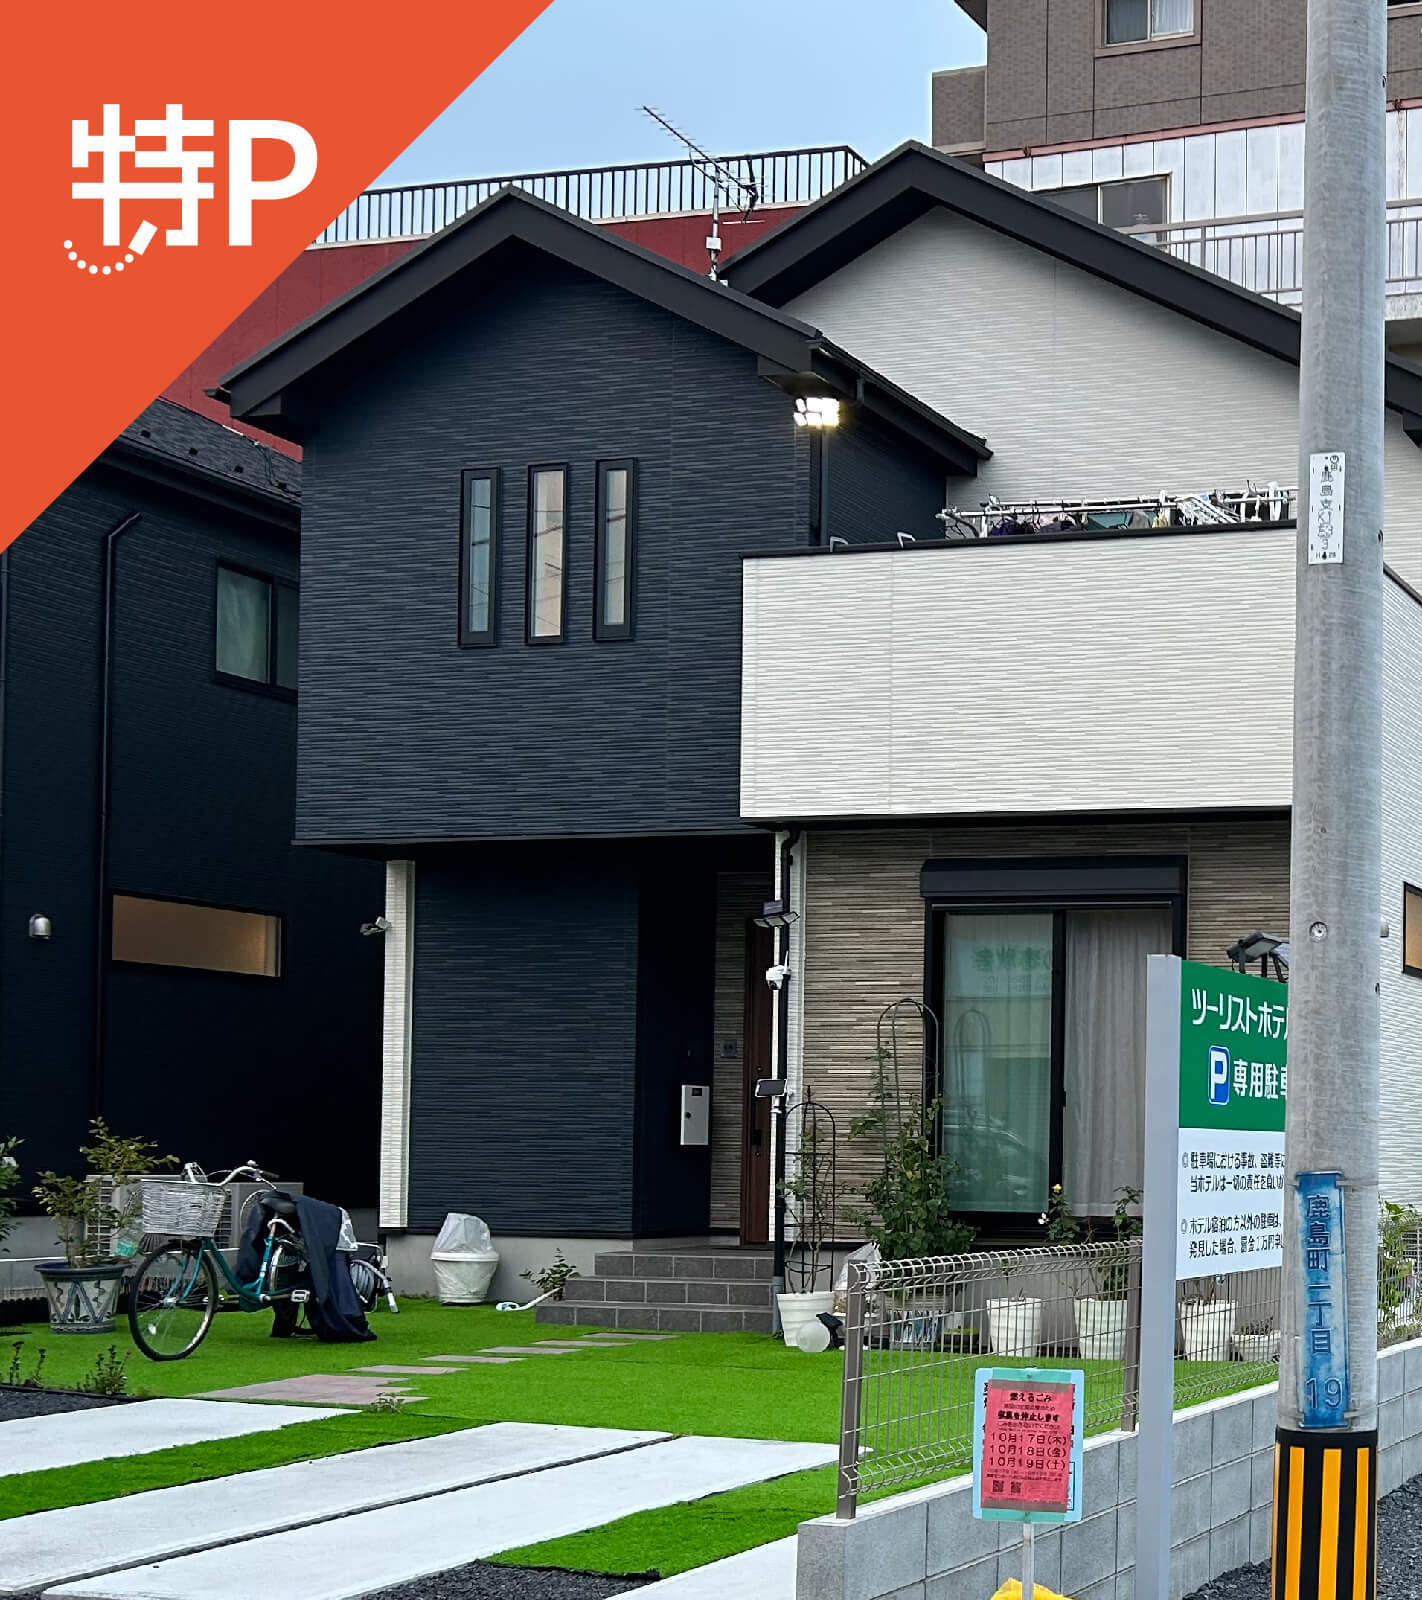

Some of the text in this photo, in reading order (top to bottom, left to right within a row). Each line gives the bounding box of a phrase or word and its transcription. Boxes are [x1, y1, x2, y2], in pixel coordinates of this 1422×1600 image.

[1191, 988, 1288, 1041] ツーリストホテ
[1306, 1377, 1343, 1410] 19
